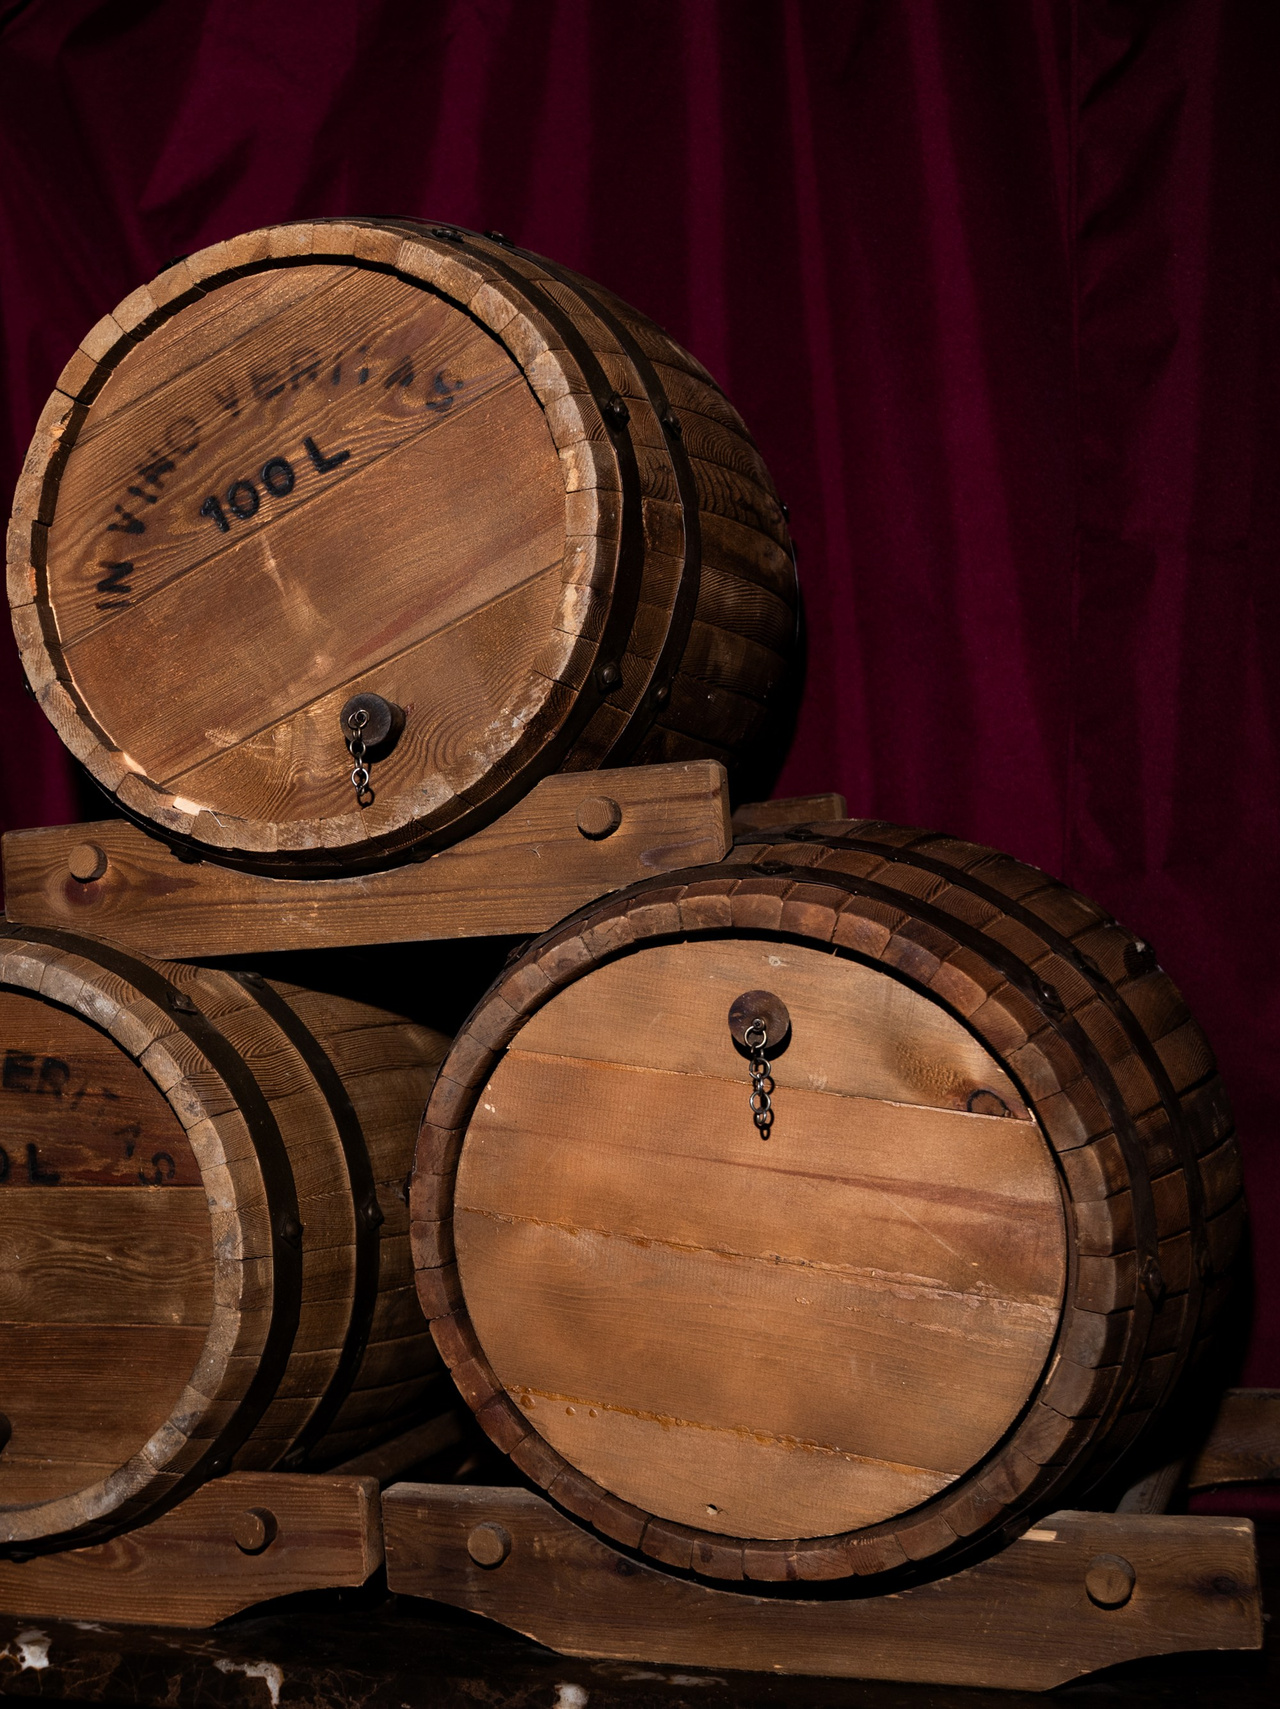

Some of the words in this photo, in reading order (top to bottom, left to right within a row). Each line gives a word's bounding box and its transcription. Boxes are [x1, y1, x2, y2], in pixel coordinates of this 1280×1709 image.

[201, 456, 295, 533] 100
[303, 436, 351, 474] L
[26, 1143, 61, 1184] L
